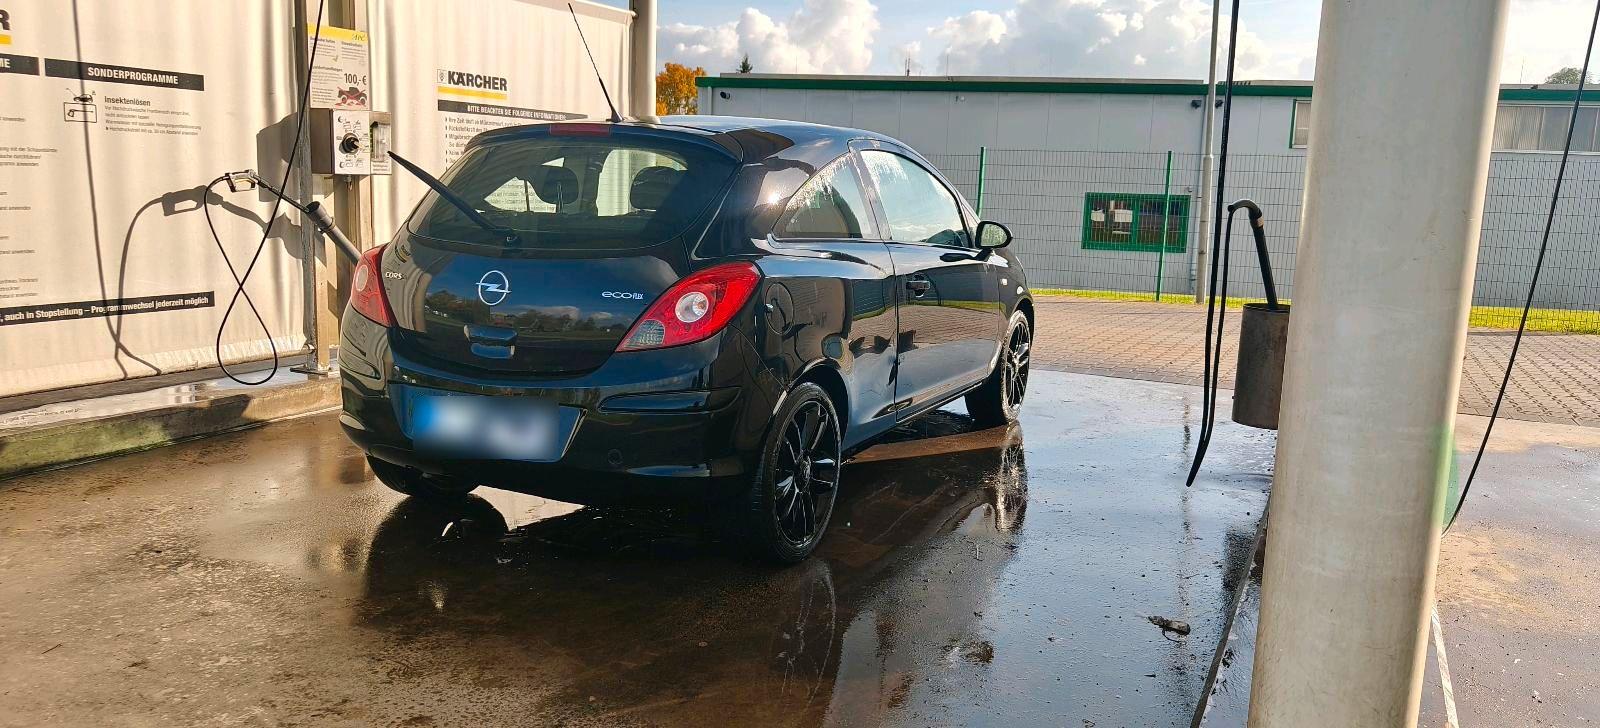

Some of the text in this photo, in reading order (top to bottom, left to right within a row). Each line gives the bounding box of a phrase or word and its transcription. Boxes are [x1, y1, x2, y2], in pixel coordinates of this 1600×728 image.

[88, 67, 178, 84] SONDERPROGRAMME
[448, 70, 507, 91] KÄRCHER
[104, 95, 151, 107] Insektenlösen
[467, 105, 480, 113] BITTE
[4, 311, 24, 321] auch
[26, 311, 34, 319] in
[35, 308, 83, 319] Stopstellung
[91, 300, 154, 313] Programmwechsel
[155, 298, 183, 309] jederzeit
[185, 296, 208, 306] möglich
